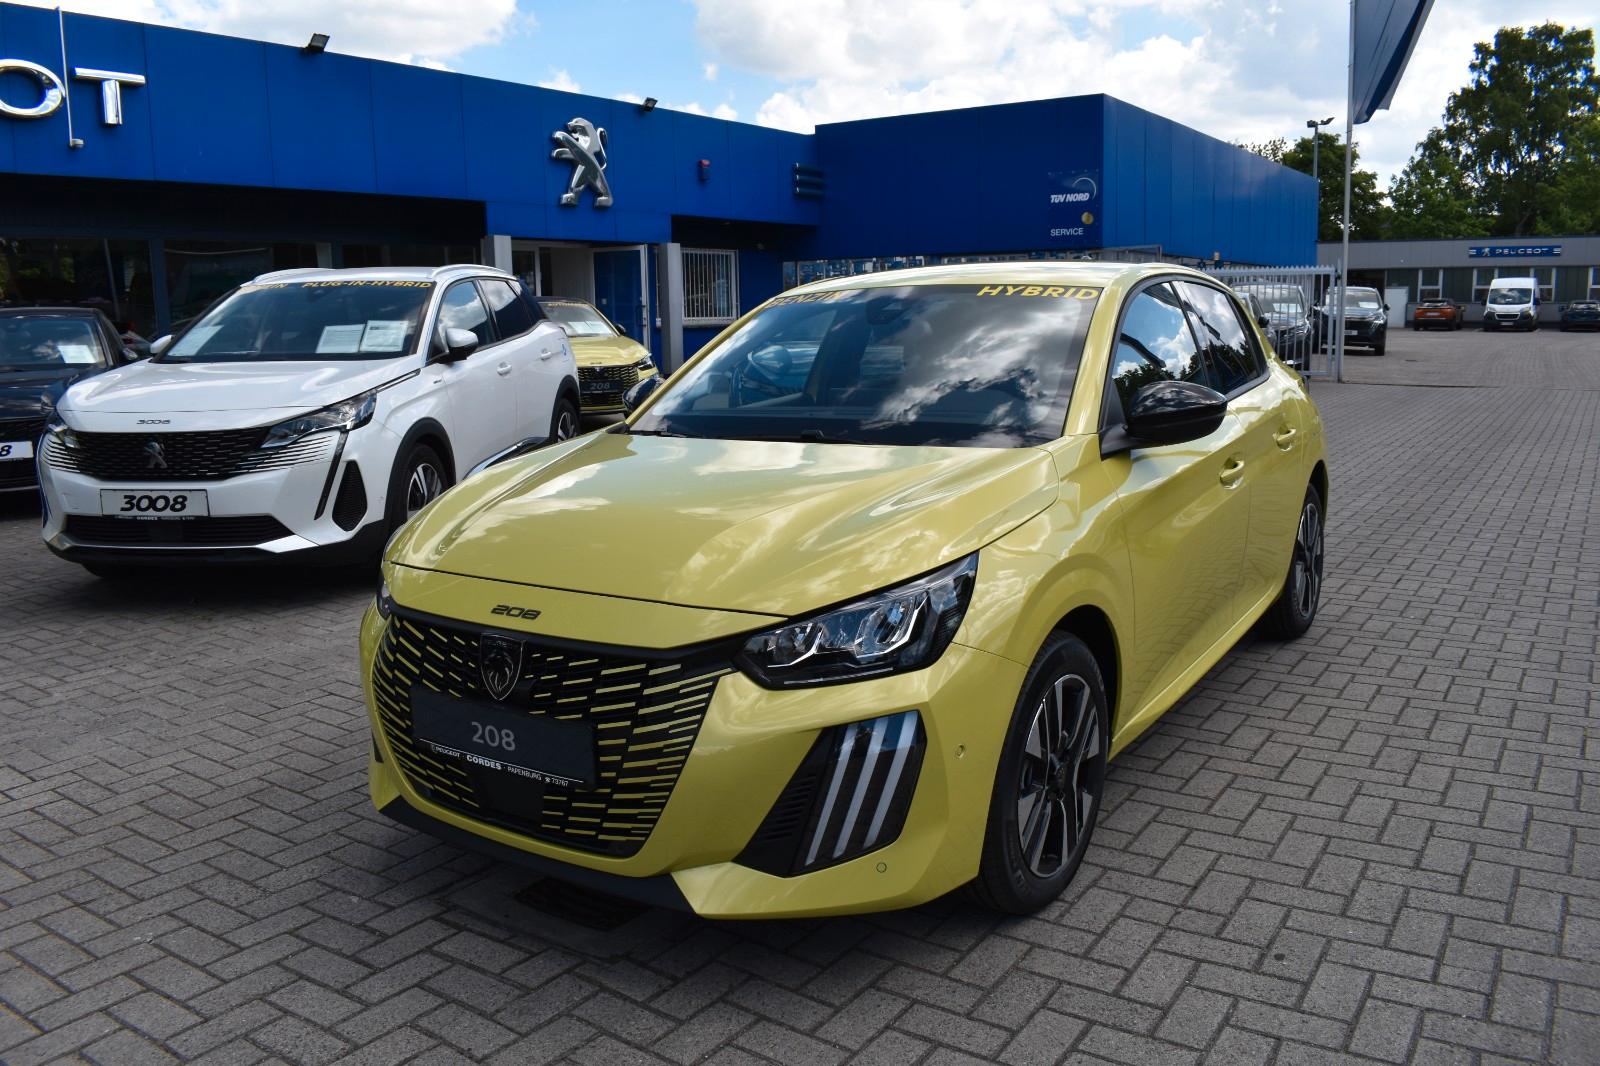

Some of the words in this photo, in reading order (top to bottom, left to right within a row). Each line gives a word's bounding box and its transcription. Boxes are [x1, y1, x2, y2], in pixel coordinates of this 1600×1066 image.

[1066, 192, 1090, 203] NORD
[1050, 227, 1084, 237] SERVICE
[301, 280, 432, 289] PLUG-IN-HYBRID
[976, 285, 1100, 300] HYBRID
[590, 382, 610, 390] 208
[120, 494, 188, 512] 3008
[490, 604, 542, 621] 208
[471, 721, 516, 751] 208
[466, 754, 502, 770] CORDES
[507, 766, 542, 781] PAPENBURG
[551, 777, 569, 787] 73767
